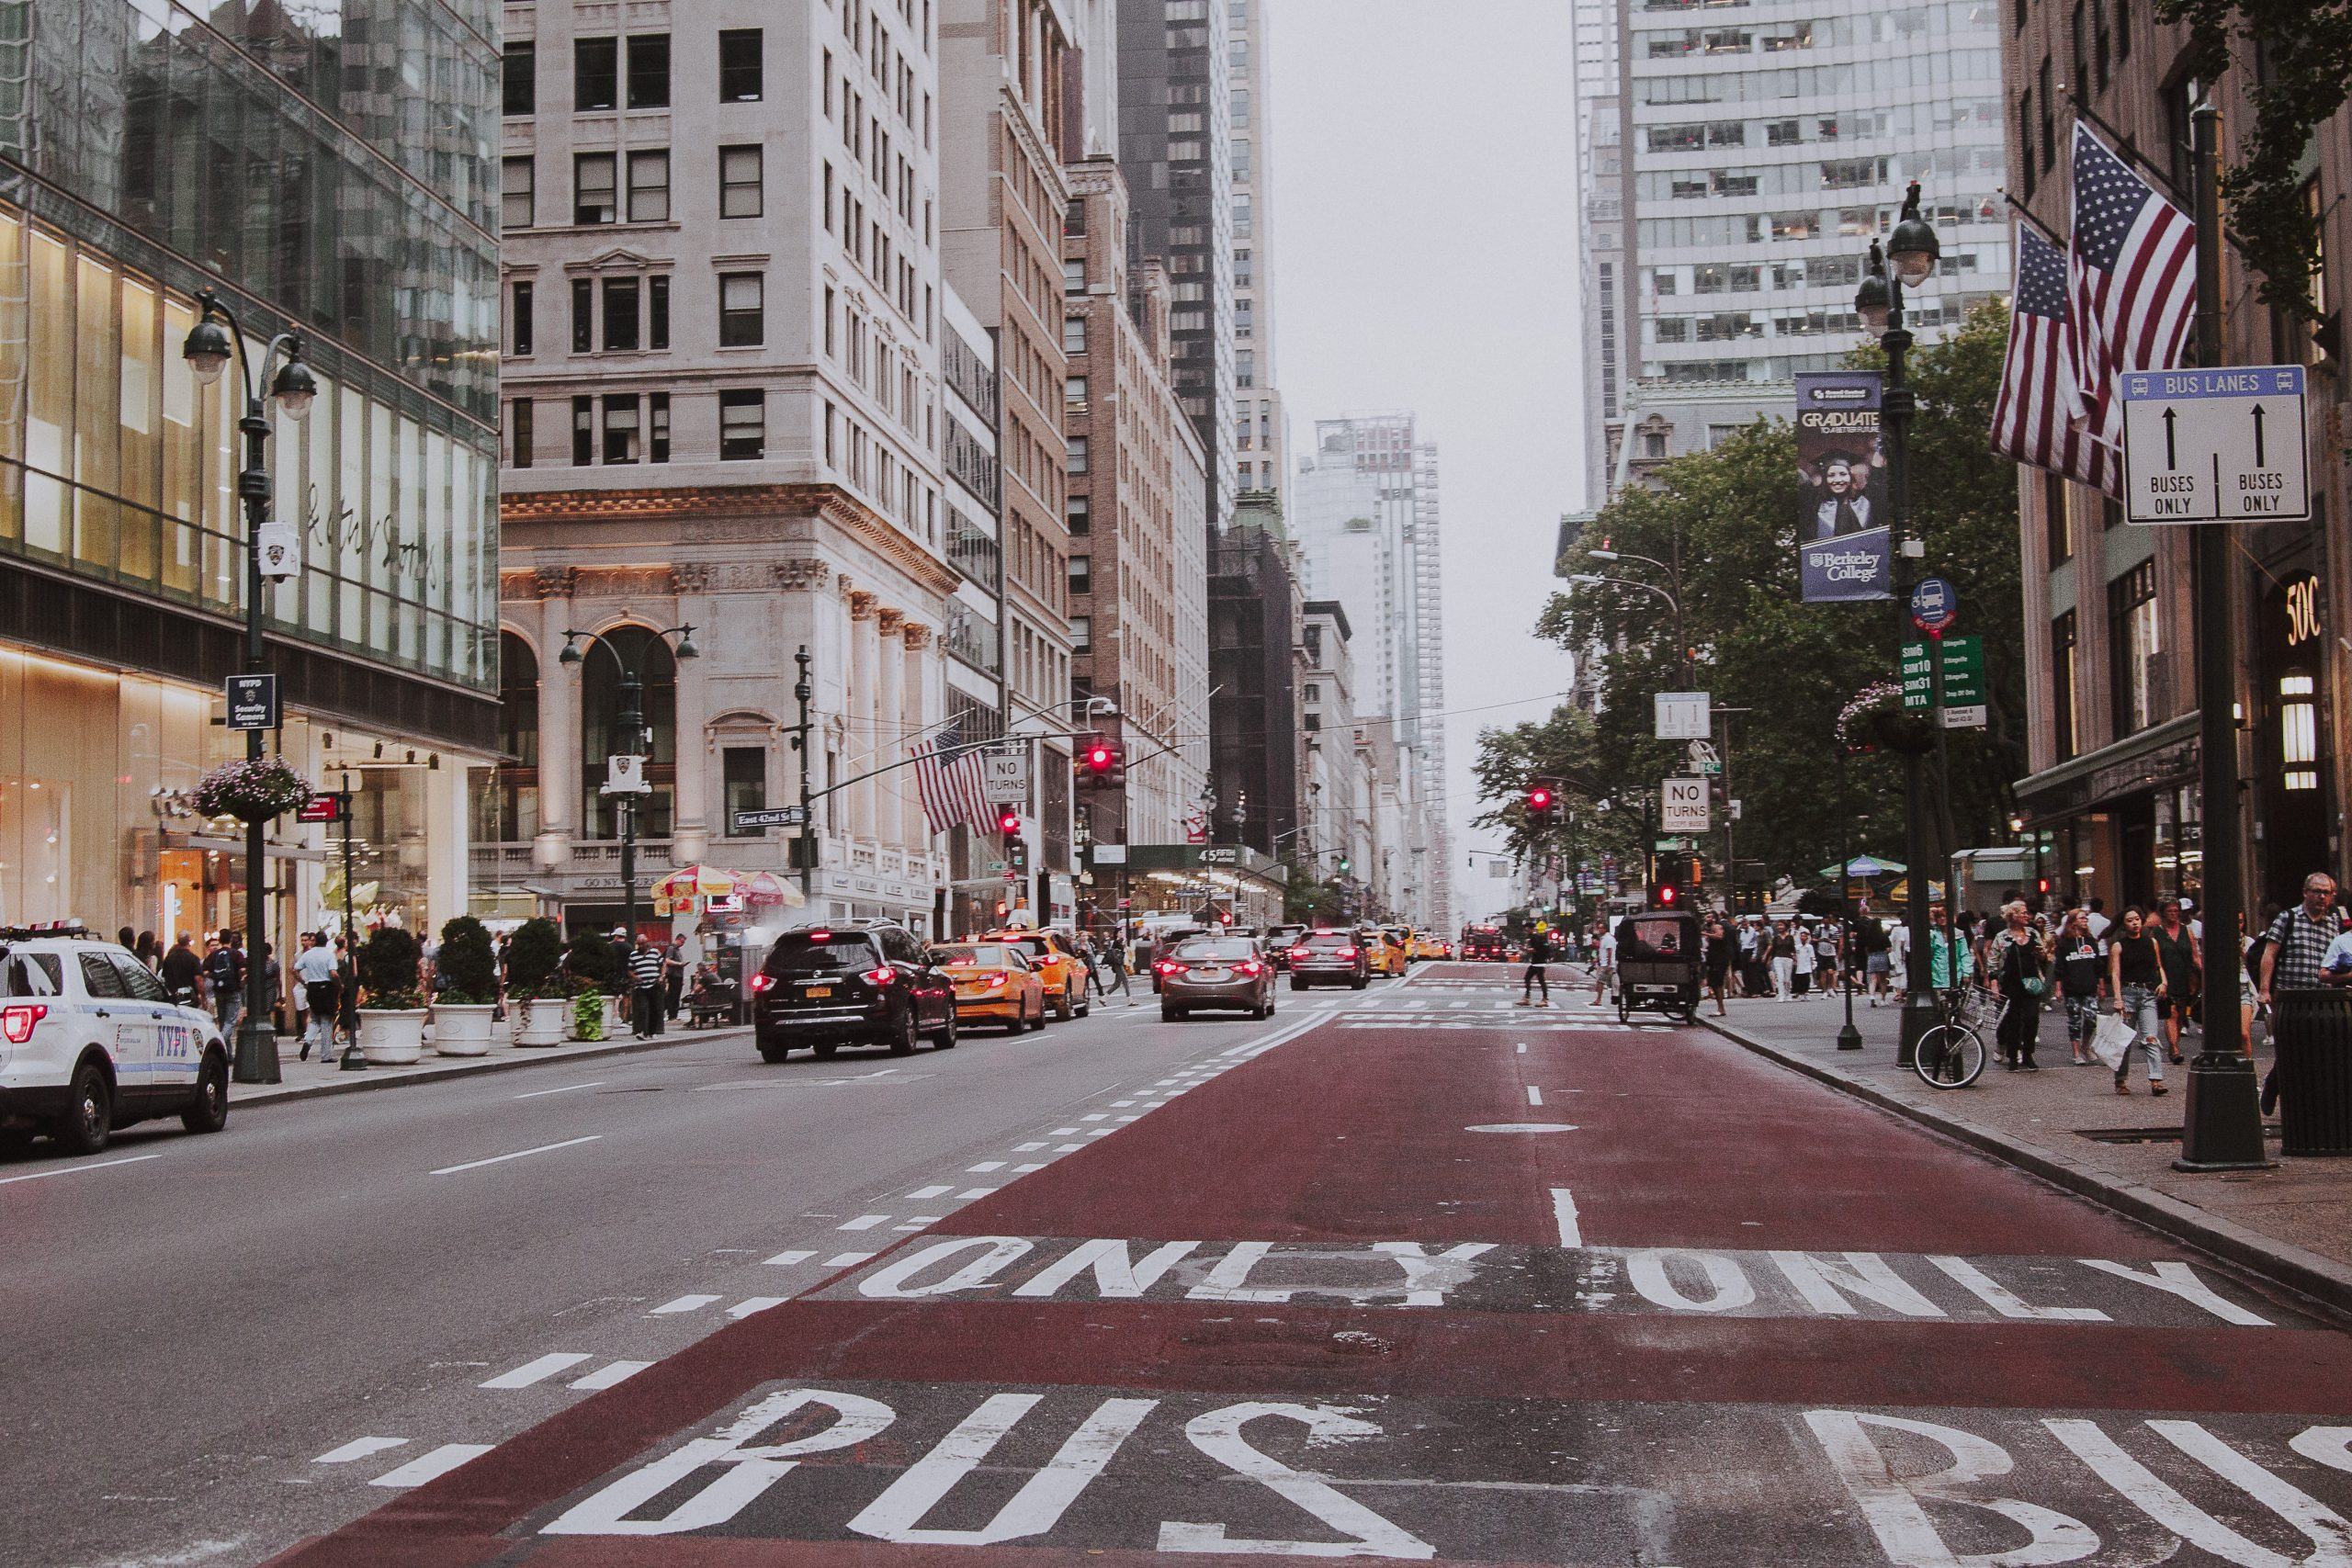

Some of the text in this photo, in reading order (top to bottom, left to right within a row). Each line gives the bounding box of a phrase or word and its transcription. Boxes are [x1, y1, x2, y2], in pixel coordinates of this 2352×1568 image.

[2165, 374, 2259, 394] BUS LANES
[1802, 412, 1881, 427] GRADUATE
[2151, 476, 2194, 492] BUSES
[2239, 473, 2283, 491] BUSES
[2154, 498, 2191, 514] ONLY
[2244, 495, 2279, 512] ONLY
[1824, 550, 1881, 568] Berkeley
[1826, 565, 1879, 582] College
[1902, 644, 1923, 658] SIM6
[1903, 660, 1930, 674] SIM10
[1904, 677, 1930, 691] SIM31
[1905, 694, 1928, 706] MTA
[234, 704, 266, 714] Security
[235, 713, 266, 721] Camera
[997, 761, 1017, 775] NO
[988, 779, 1025, 790] TURNS
[1672, 785, 1699, 800] NO
[1666, 806, 1706, 817] TURNS
[738, 816, 757, 825] East
[758, 814, 780, 823] 42nd
[584, 877, 600, 887] GO
[157, 1025, 188, 1057] NYPD
[858, 1236, 1498, 1306] ONLY
[1627, 1247, 2277, 1326] ONLY
[539, 1388, 1437, 1559] BUS
